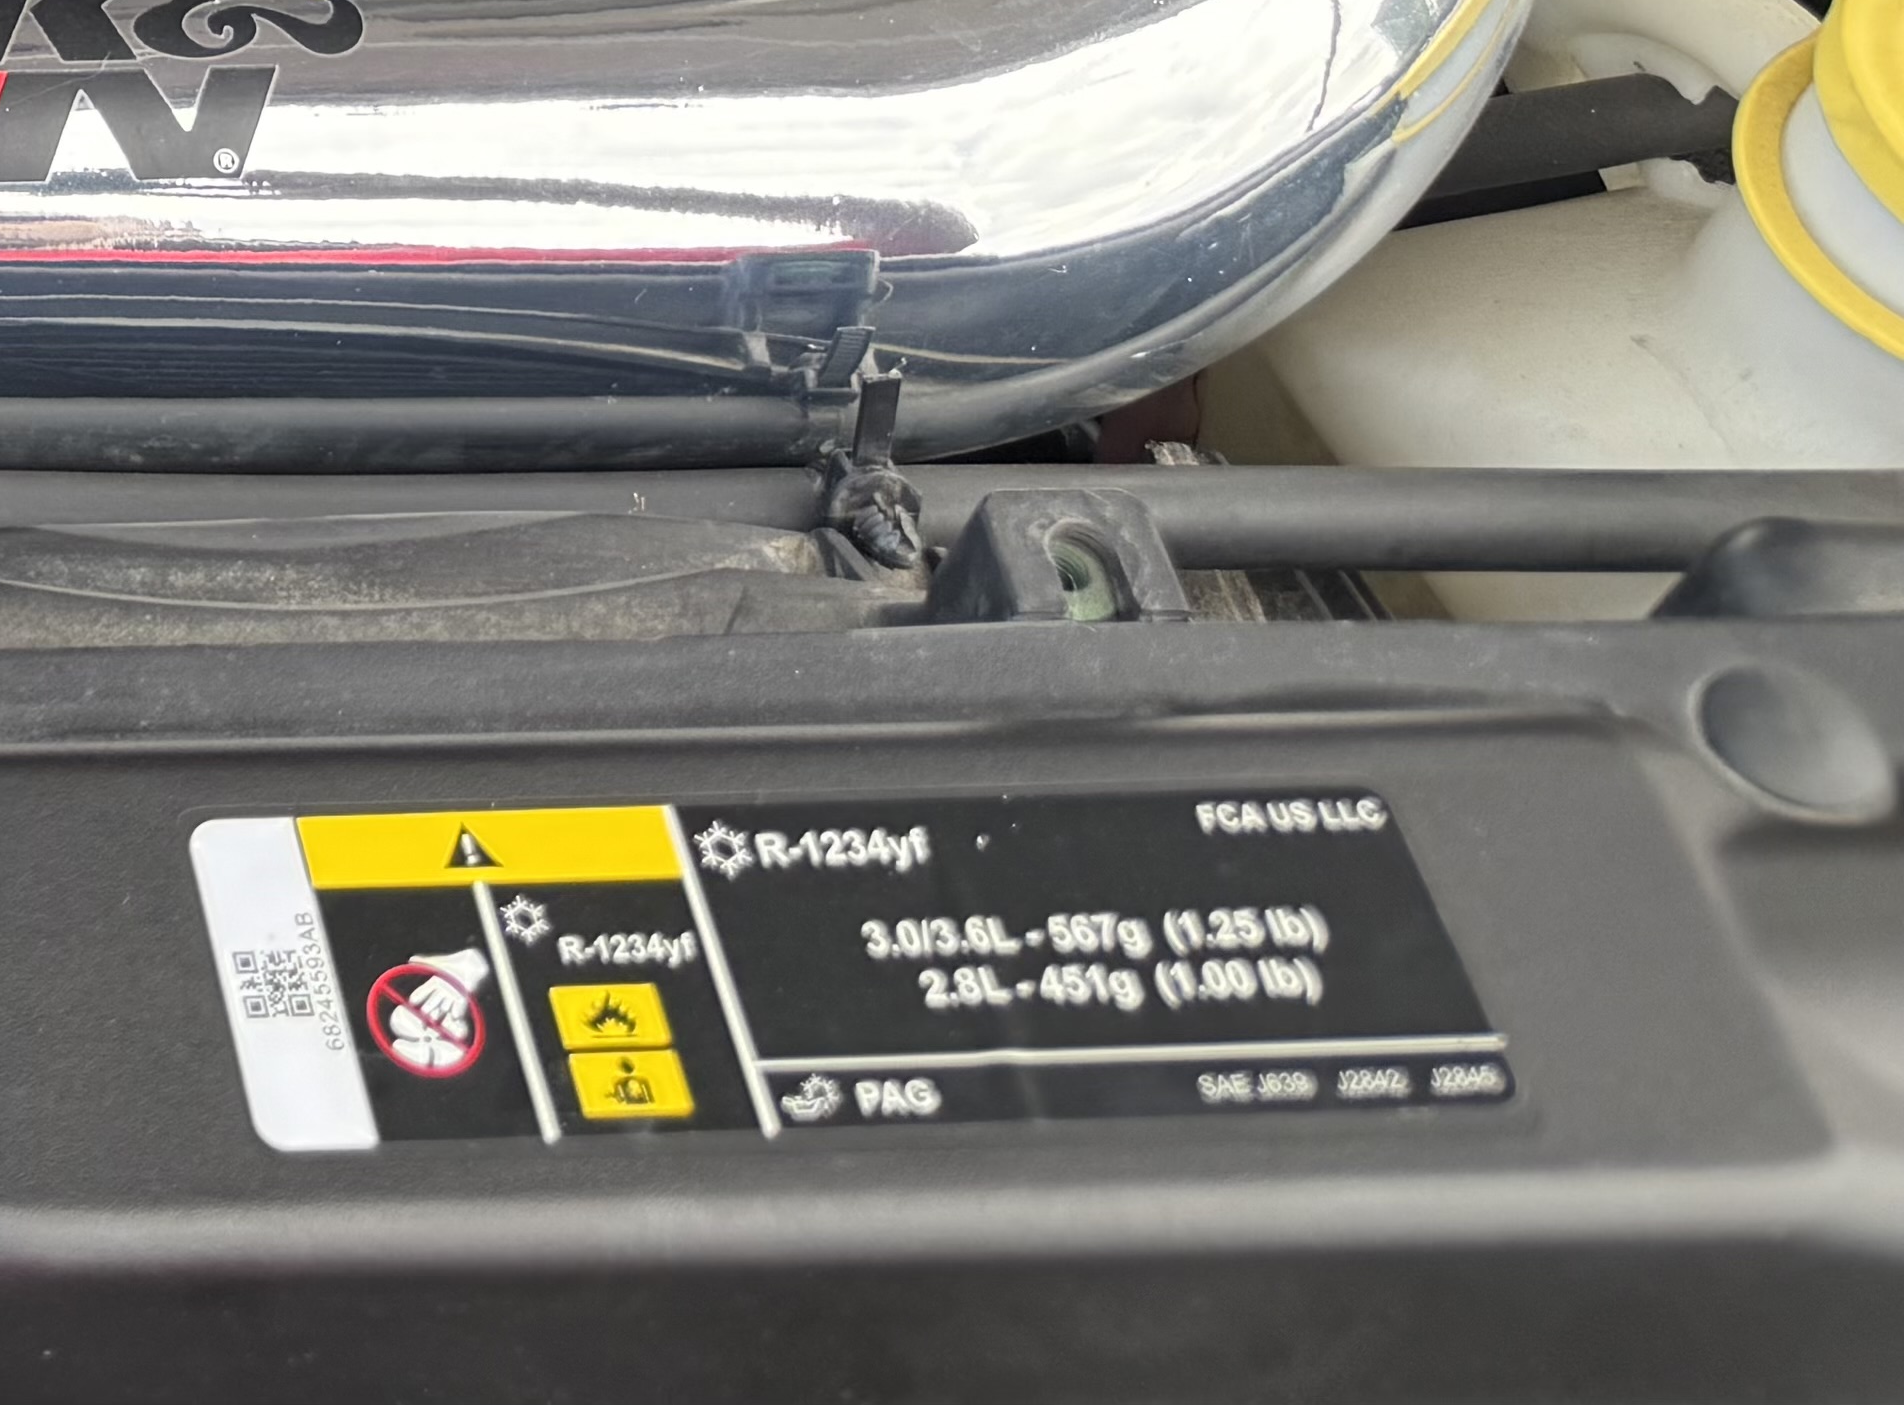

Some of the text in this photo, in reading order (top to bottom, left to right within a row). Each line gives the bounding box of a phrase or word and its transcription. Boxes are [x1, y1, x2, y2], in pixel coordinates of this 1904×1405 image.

[1195, 796, 1388, 835] FCA US LLC
[754, 825, 930, 872] R-1234yf
[557, 931, 695, 970] R-1234yf
[861, 914, 1022, 959] 3.0/3.6L
[1046, 910, 1153, 960] 567g
[1161, 907, 1266, 957] (1.25
[1263, 904, 1332, 955] lb)
[294, 912, 345, 1051] 68245593AB
[918, 965, 1013, 1009] 2.8L
[1039, 962, 1146, 1012] 451g
[1154, 957, 1258, 1010] (1.00
[1256, 954, 1324, 1006] lb)
[853, 1077, 943, 1117] PAG
[1196, 1073, 1253, 1104] SAE
[1255, 1068, 1319, 1102] J639
[1335, 1065, 1413, 1099] J2842
